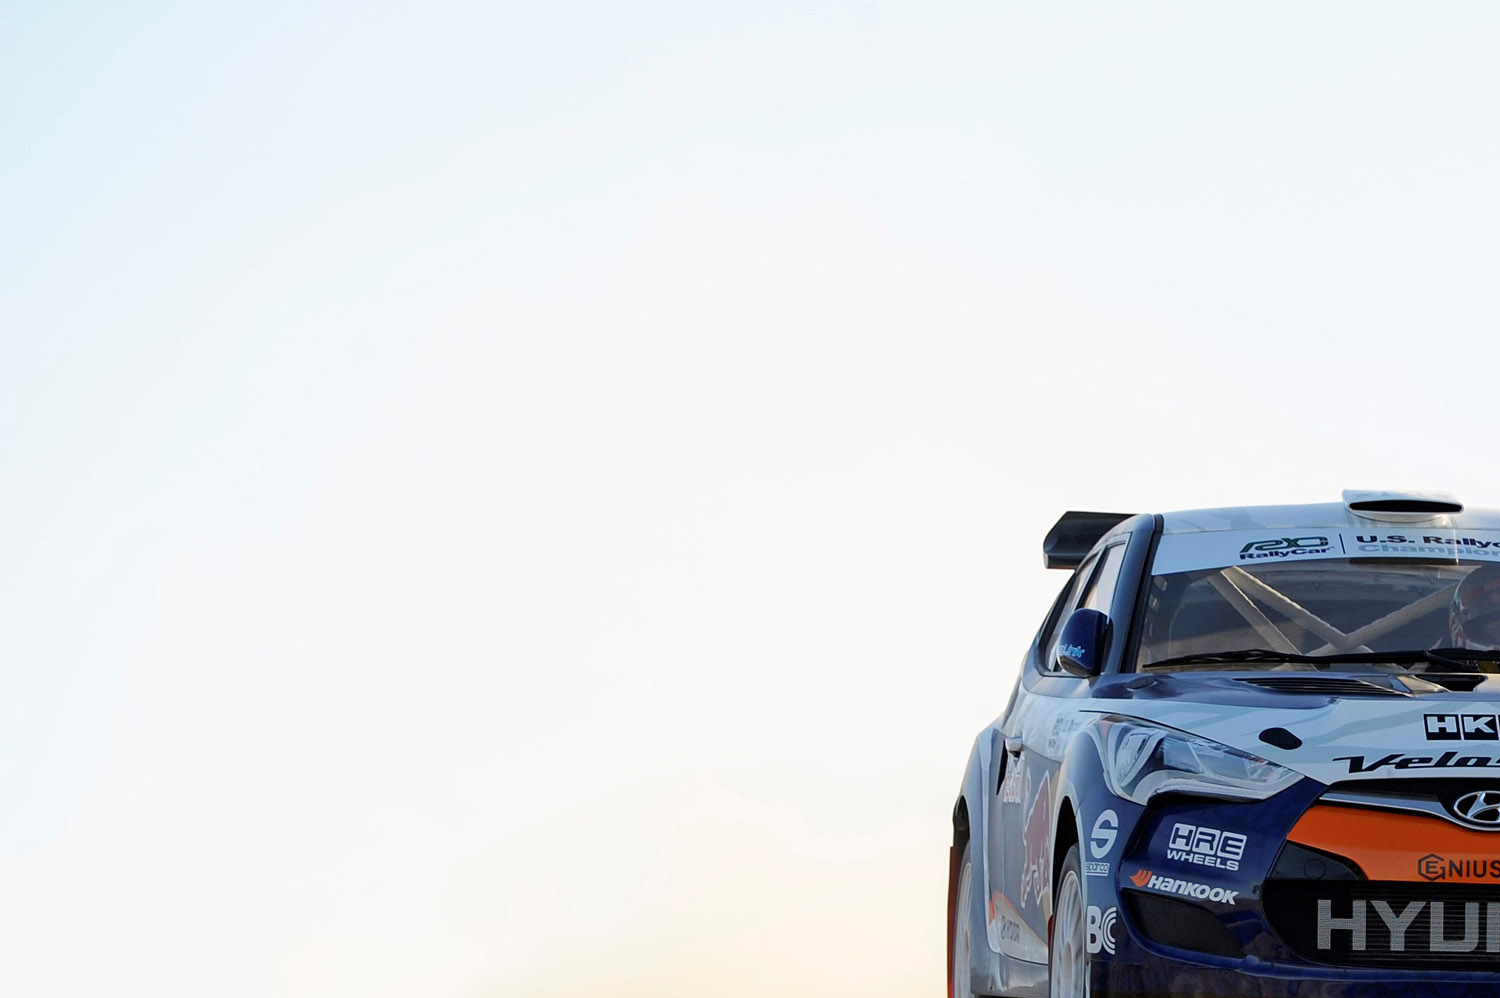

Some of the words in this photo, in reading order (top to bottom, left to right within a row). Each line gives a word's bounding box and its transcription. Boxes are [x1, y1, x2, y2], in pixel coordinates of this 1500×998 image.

[1356, 534, 1416, 545] U.S.
[1239, 547, 1333, 560] RallyCar
[1168, 823, 1247, 860] HRE
[1166, 849, 1240, 871] WHEELS
